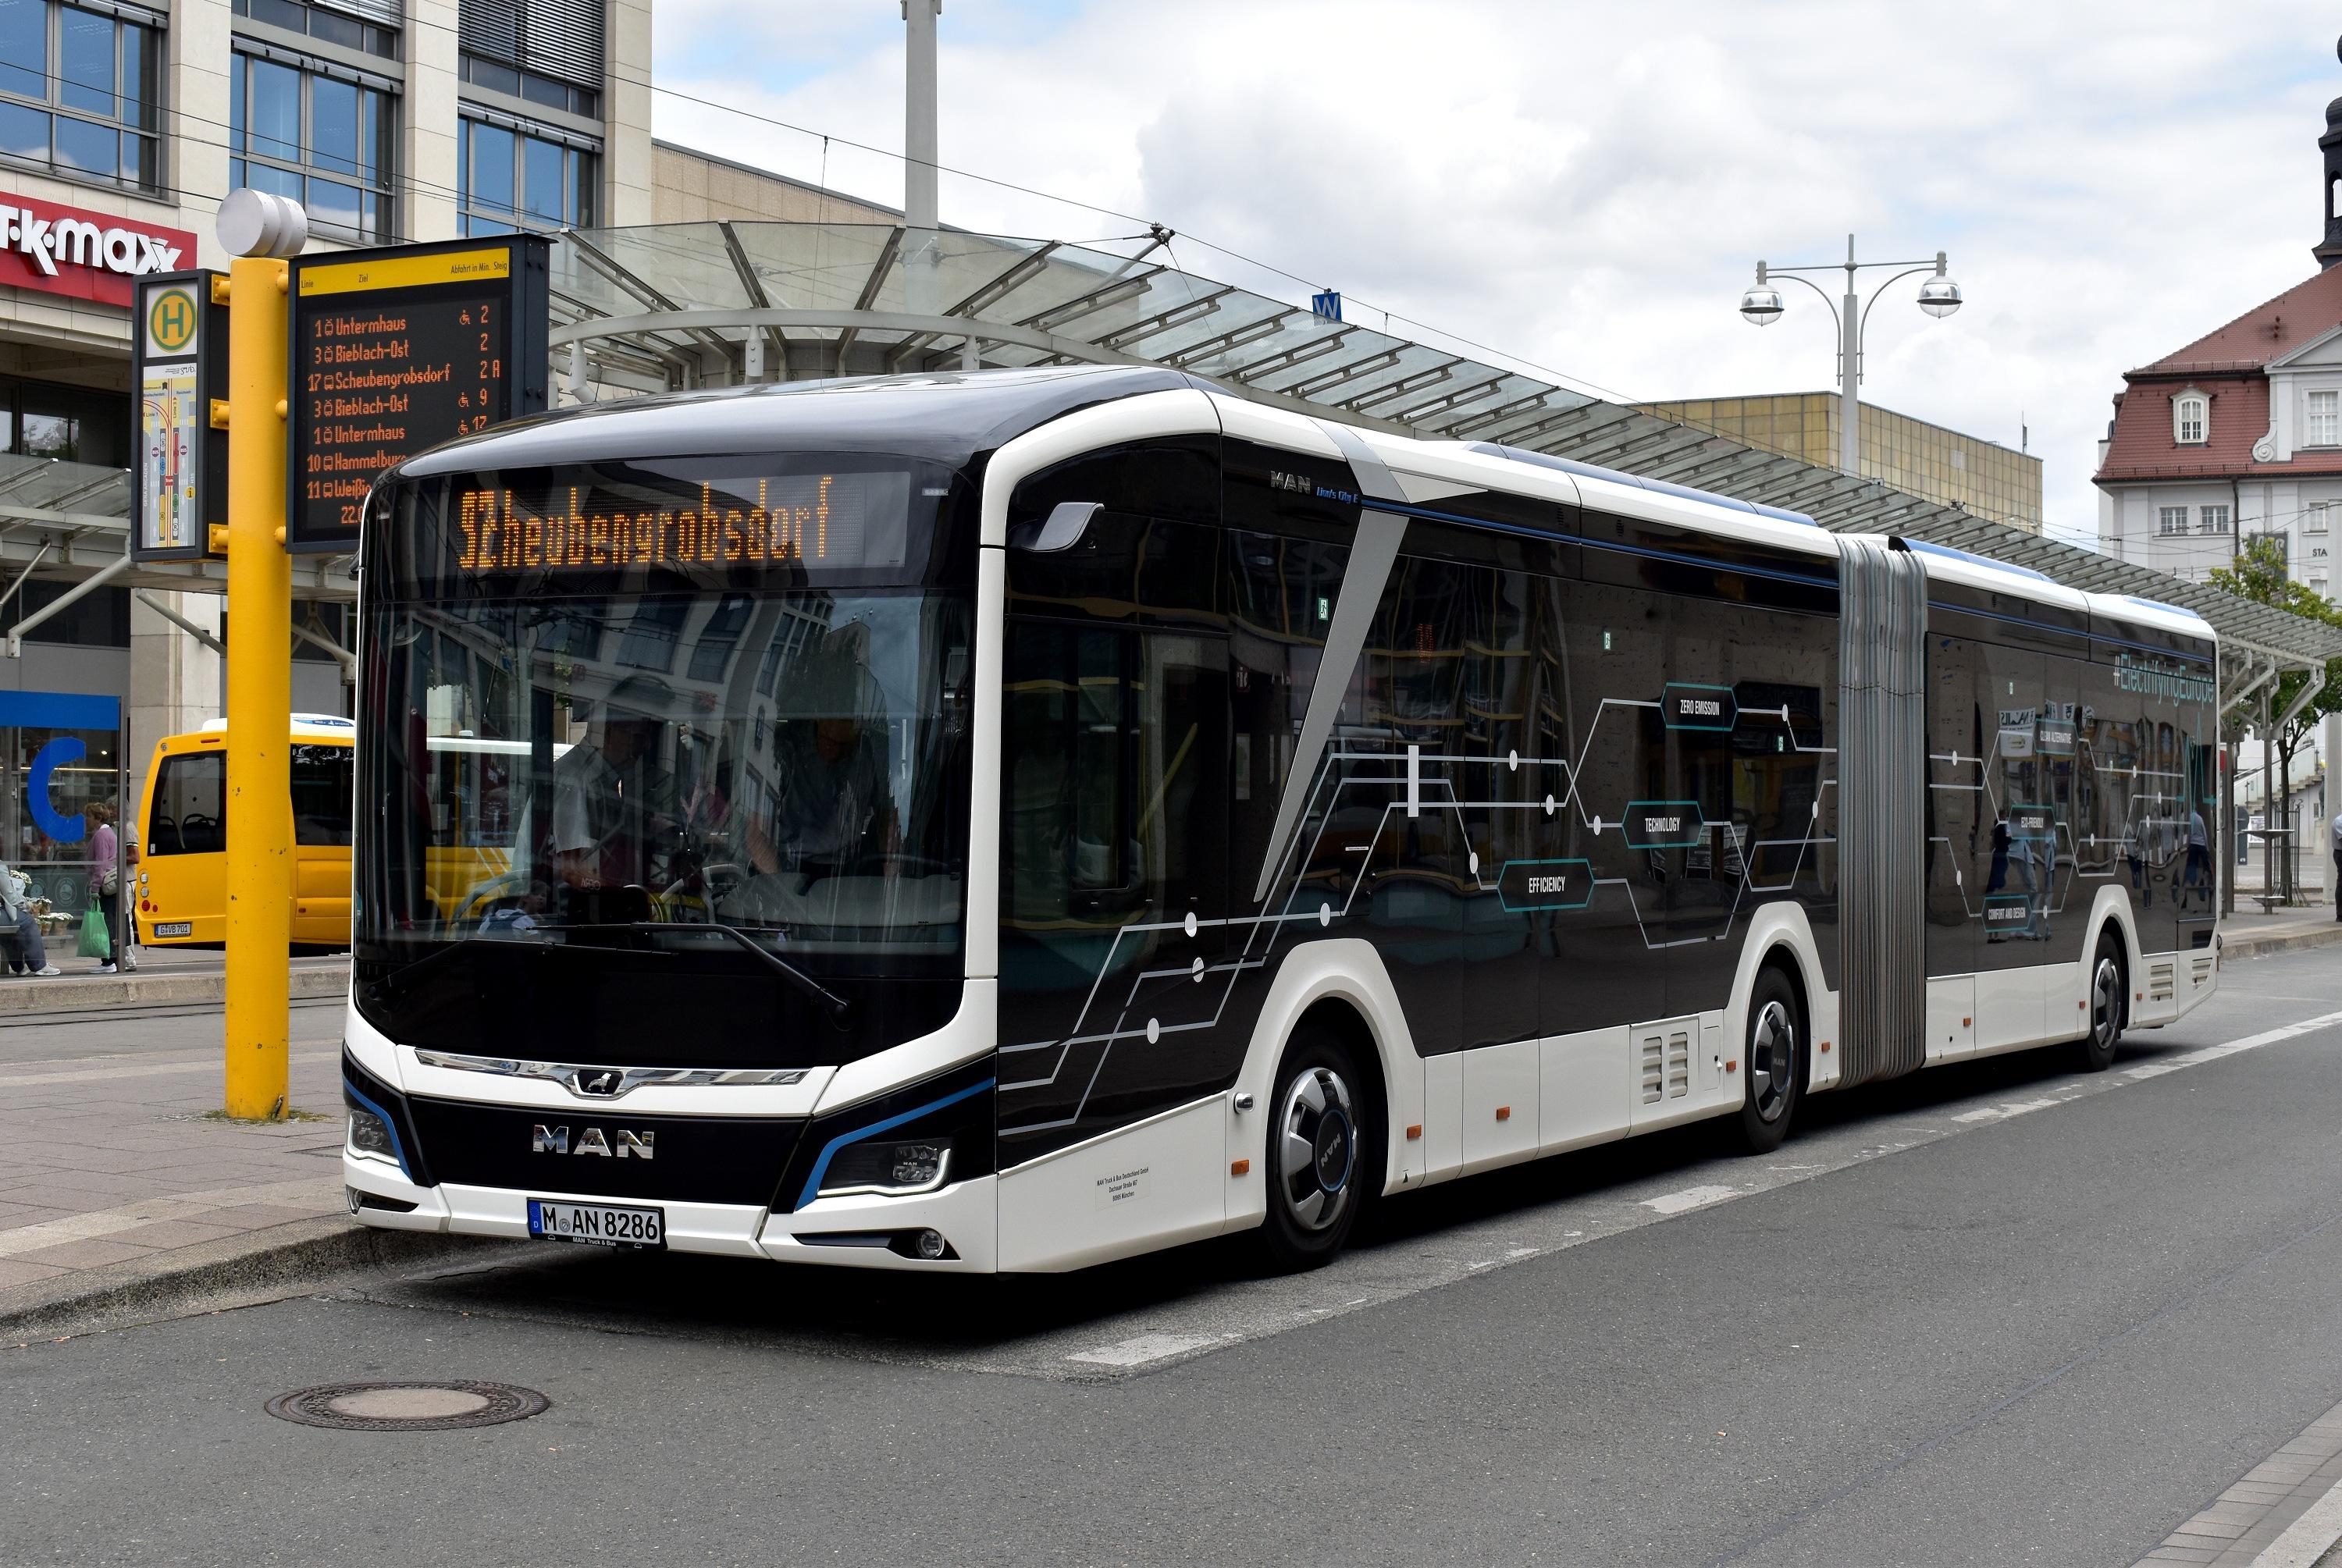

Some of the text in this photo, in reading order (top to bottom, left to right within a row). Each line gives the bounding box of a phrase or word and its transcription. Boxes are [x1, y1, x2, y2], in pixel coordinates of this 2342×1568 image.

[450, 263, 490, 274] Abfahrt in Min.
[493, 261, 507, 271] Steig
[301, 279, 314, 288] Linie
[358, 274, 368, 283] Ziel
[162, 302, 184, 339] H
[315, 305, 489, 338] 1 Untermhaus 2
[314, 332, 488, 364] 3 Bieblach-Ost 2
[308, 359, 500, 392] 17 Scheubengrobsdorf 2 A
[314, 388, 488, 418] 3 Bieblach-Ost 9
[314, 415, 487, 445] 1 Untermhaus 17
[307, 454, 321, 473] 10
[306, 480, 320, 499] 11
[1270, 470, 1311, 494] MAN
[2312, 548, 2328, 556] STA
[2113, 653, 2214, 710] #ElectrifyingEurope
[1680, 699, 1719, 716] ZERO EMISSION
[1645, 817, 1680, 832] TECHNOLOGY
[1529, 876, 1566, 893] EFFICIENCY
[533, 1124, 654, 1159] MAN
[1320, 1132, 1341, 1168] MAN
[543, 1207, 557, 1231] M
[572, 1209, 599, 1235] AN
[604, 1212, 658, 1240] 8286
